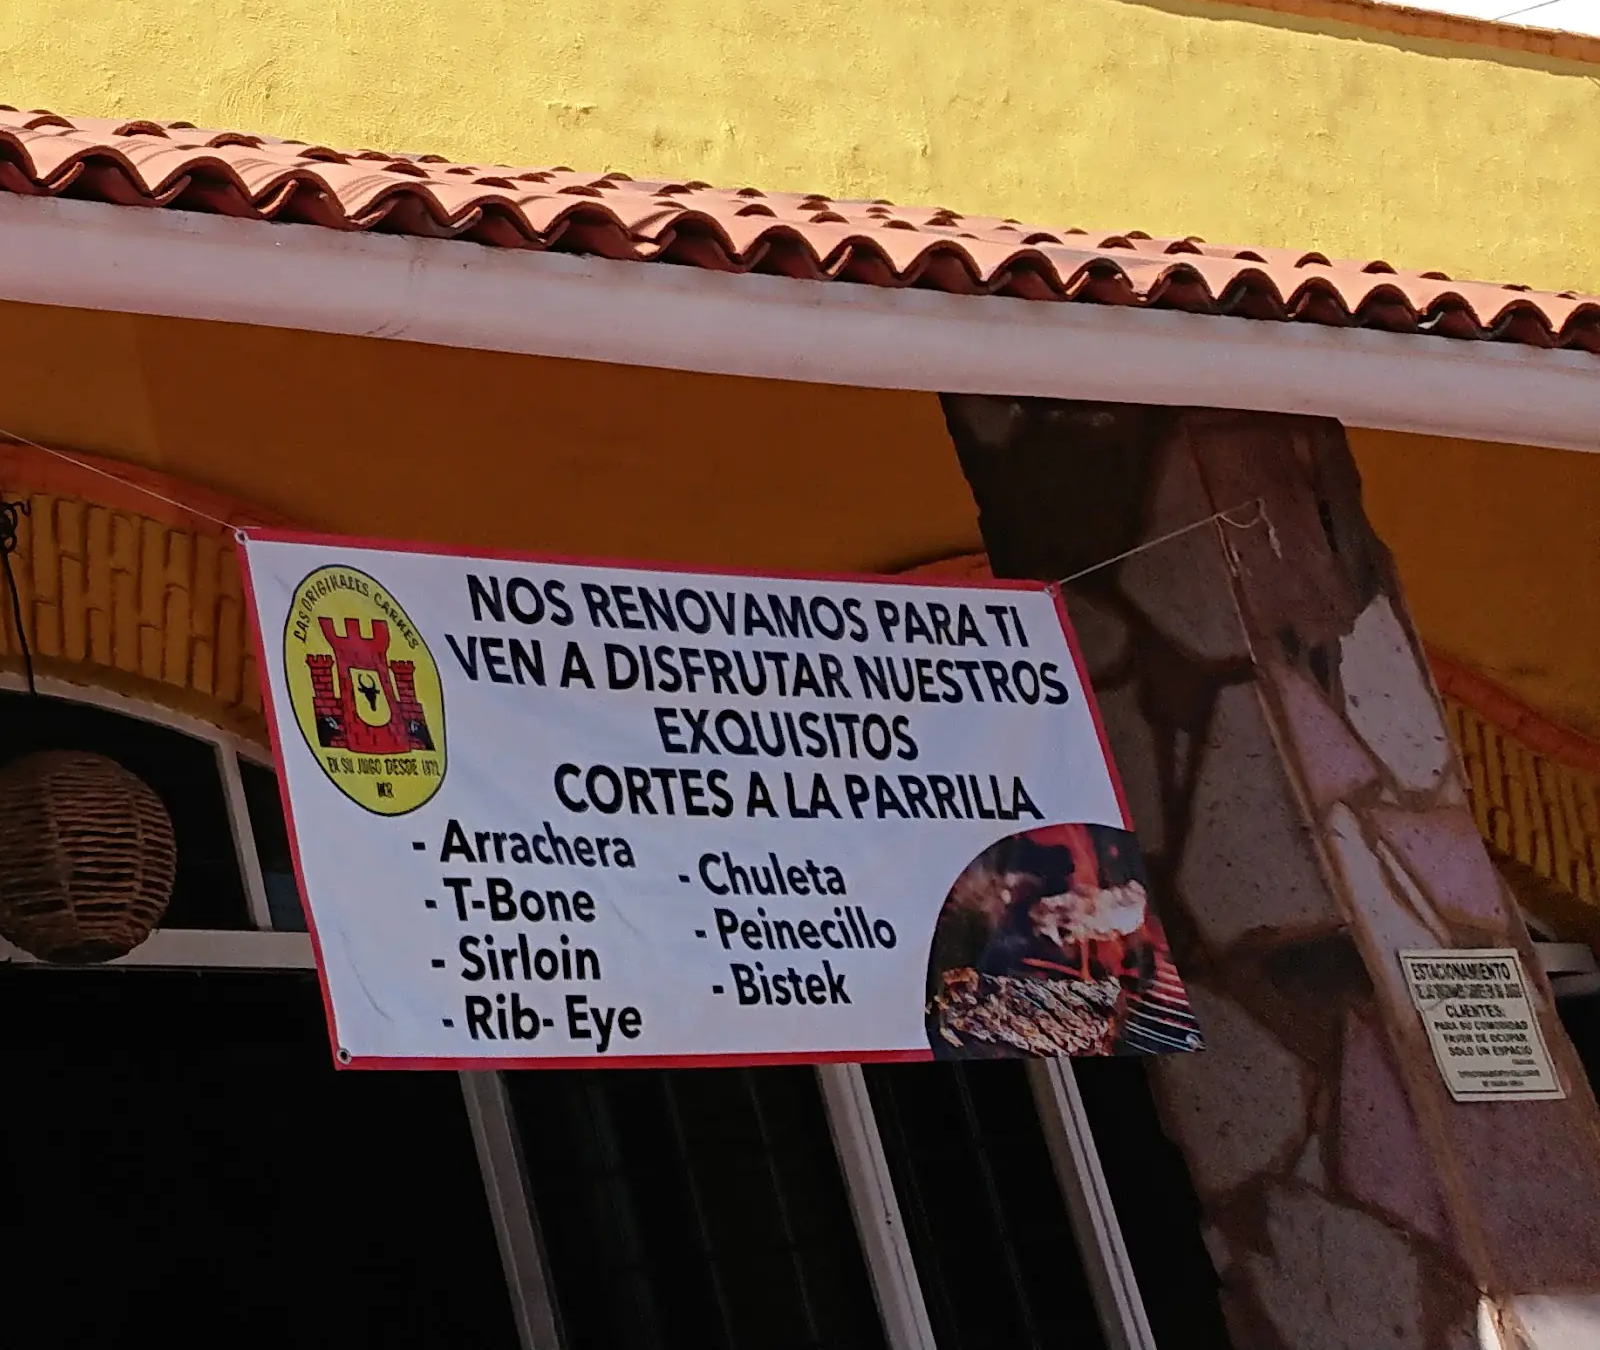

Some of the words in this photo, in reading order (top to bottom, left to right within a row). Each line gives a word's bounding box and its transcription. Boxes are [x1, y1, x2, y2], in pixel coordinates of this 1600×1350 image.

[465, 572, 575, 628] NOS
[579, 581, 871, 643] RENOVAMOS
[874, 598, 988, 648] PARA
[985, 604, 1029, 648] TI
[444, 632, 547, 687] VEN
[559, 640, 596, 690] A
[604, 642, 852, 700] DISFRUTAR
[855, 654, 1070, 706] NUESTROS
[652, 706, 920, 762] EXQUISITOS
[553, 762, 735, 819] CORTES
[746, 770, 780, 819] A
[785, 770, 842, 820] LA
[843, 772, 1046, 822] PARRILLA
[439, 818, 637, 869] Arrachera
[699, 851, 848, 897] Chuleta
[442, 876, 597, 924] T-Bone
[713, 905, 898, 953] Peinecillo
[458, 933, 602, 983] Sirloin
[729, 959, 854, 1008] Bistek
